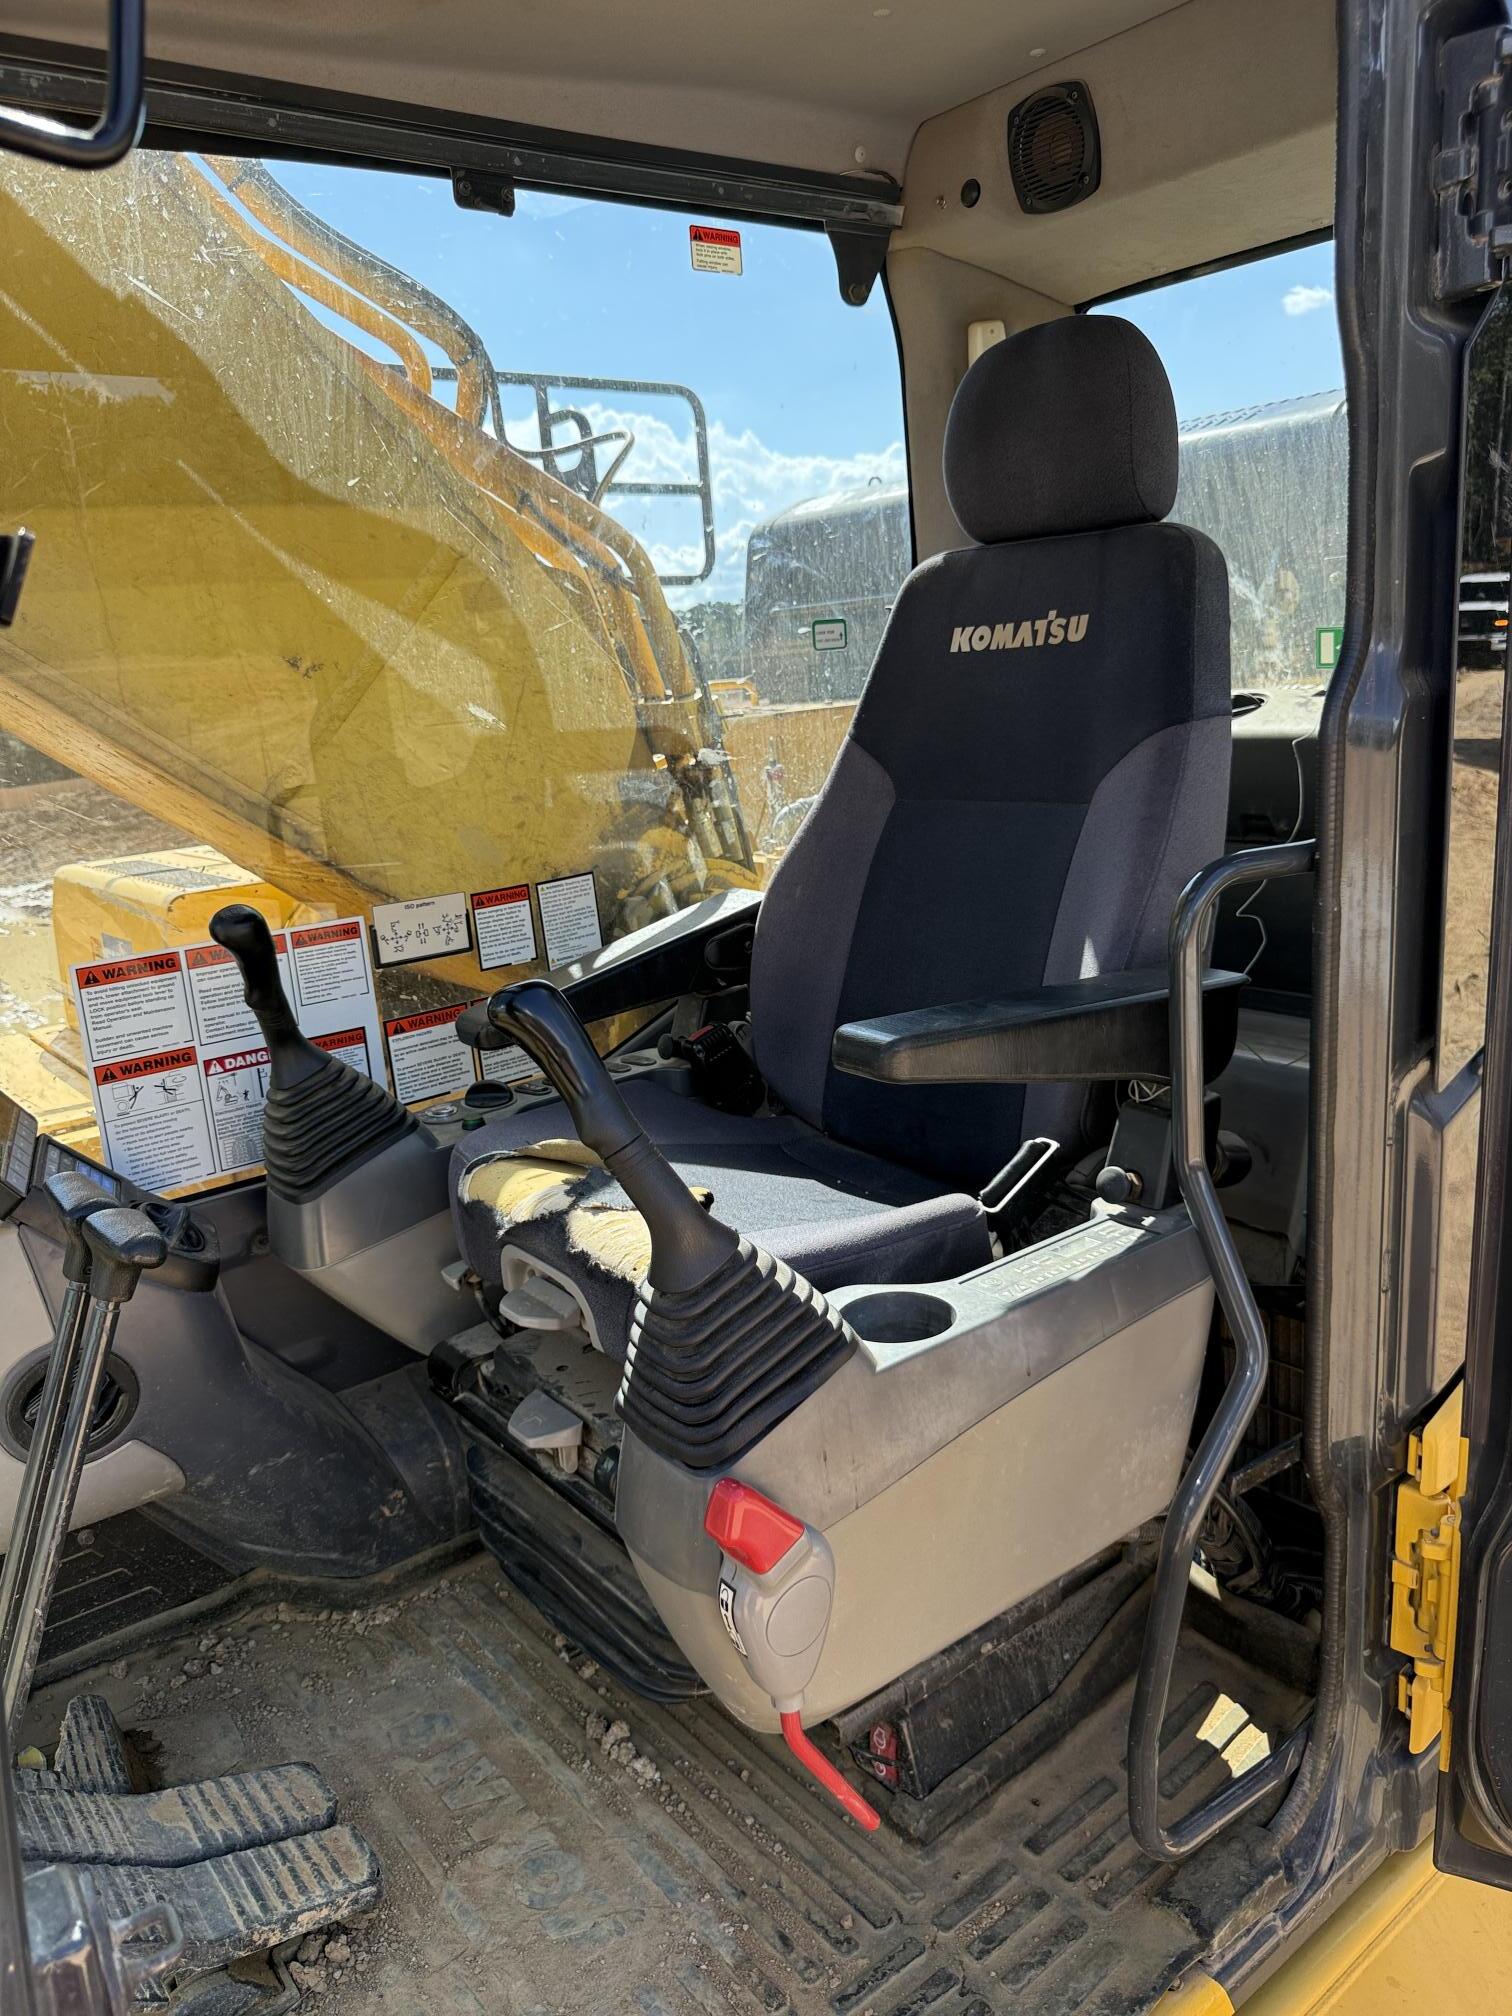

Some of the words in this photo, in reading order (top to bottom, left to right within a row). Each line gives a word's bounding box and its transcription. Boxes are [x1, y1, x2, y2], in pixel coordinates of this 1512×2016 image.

[703, 231, 737, 242] WARNING
[950, 610, 1090, 653] KOMATSU
[486, 890, 525, 903] WARNING
[308, 927, 356, 940] WARNING
[102, 958, 175, 978] WARNING
[144, 1006, 174, 1014] Maintenance
[408, 1009, 459, 1028] WARNING
[120, 1052, 191, 1074] WARNING
[224, 1051, 270, 1069] DANG
